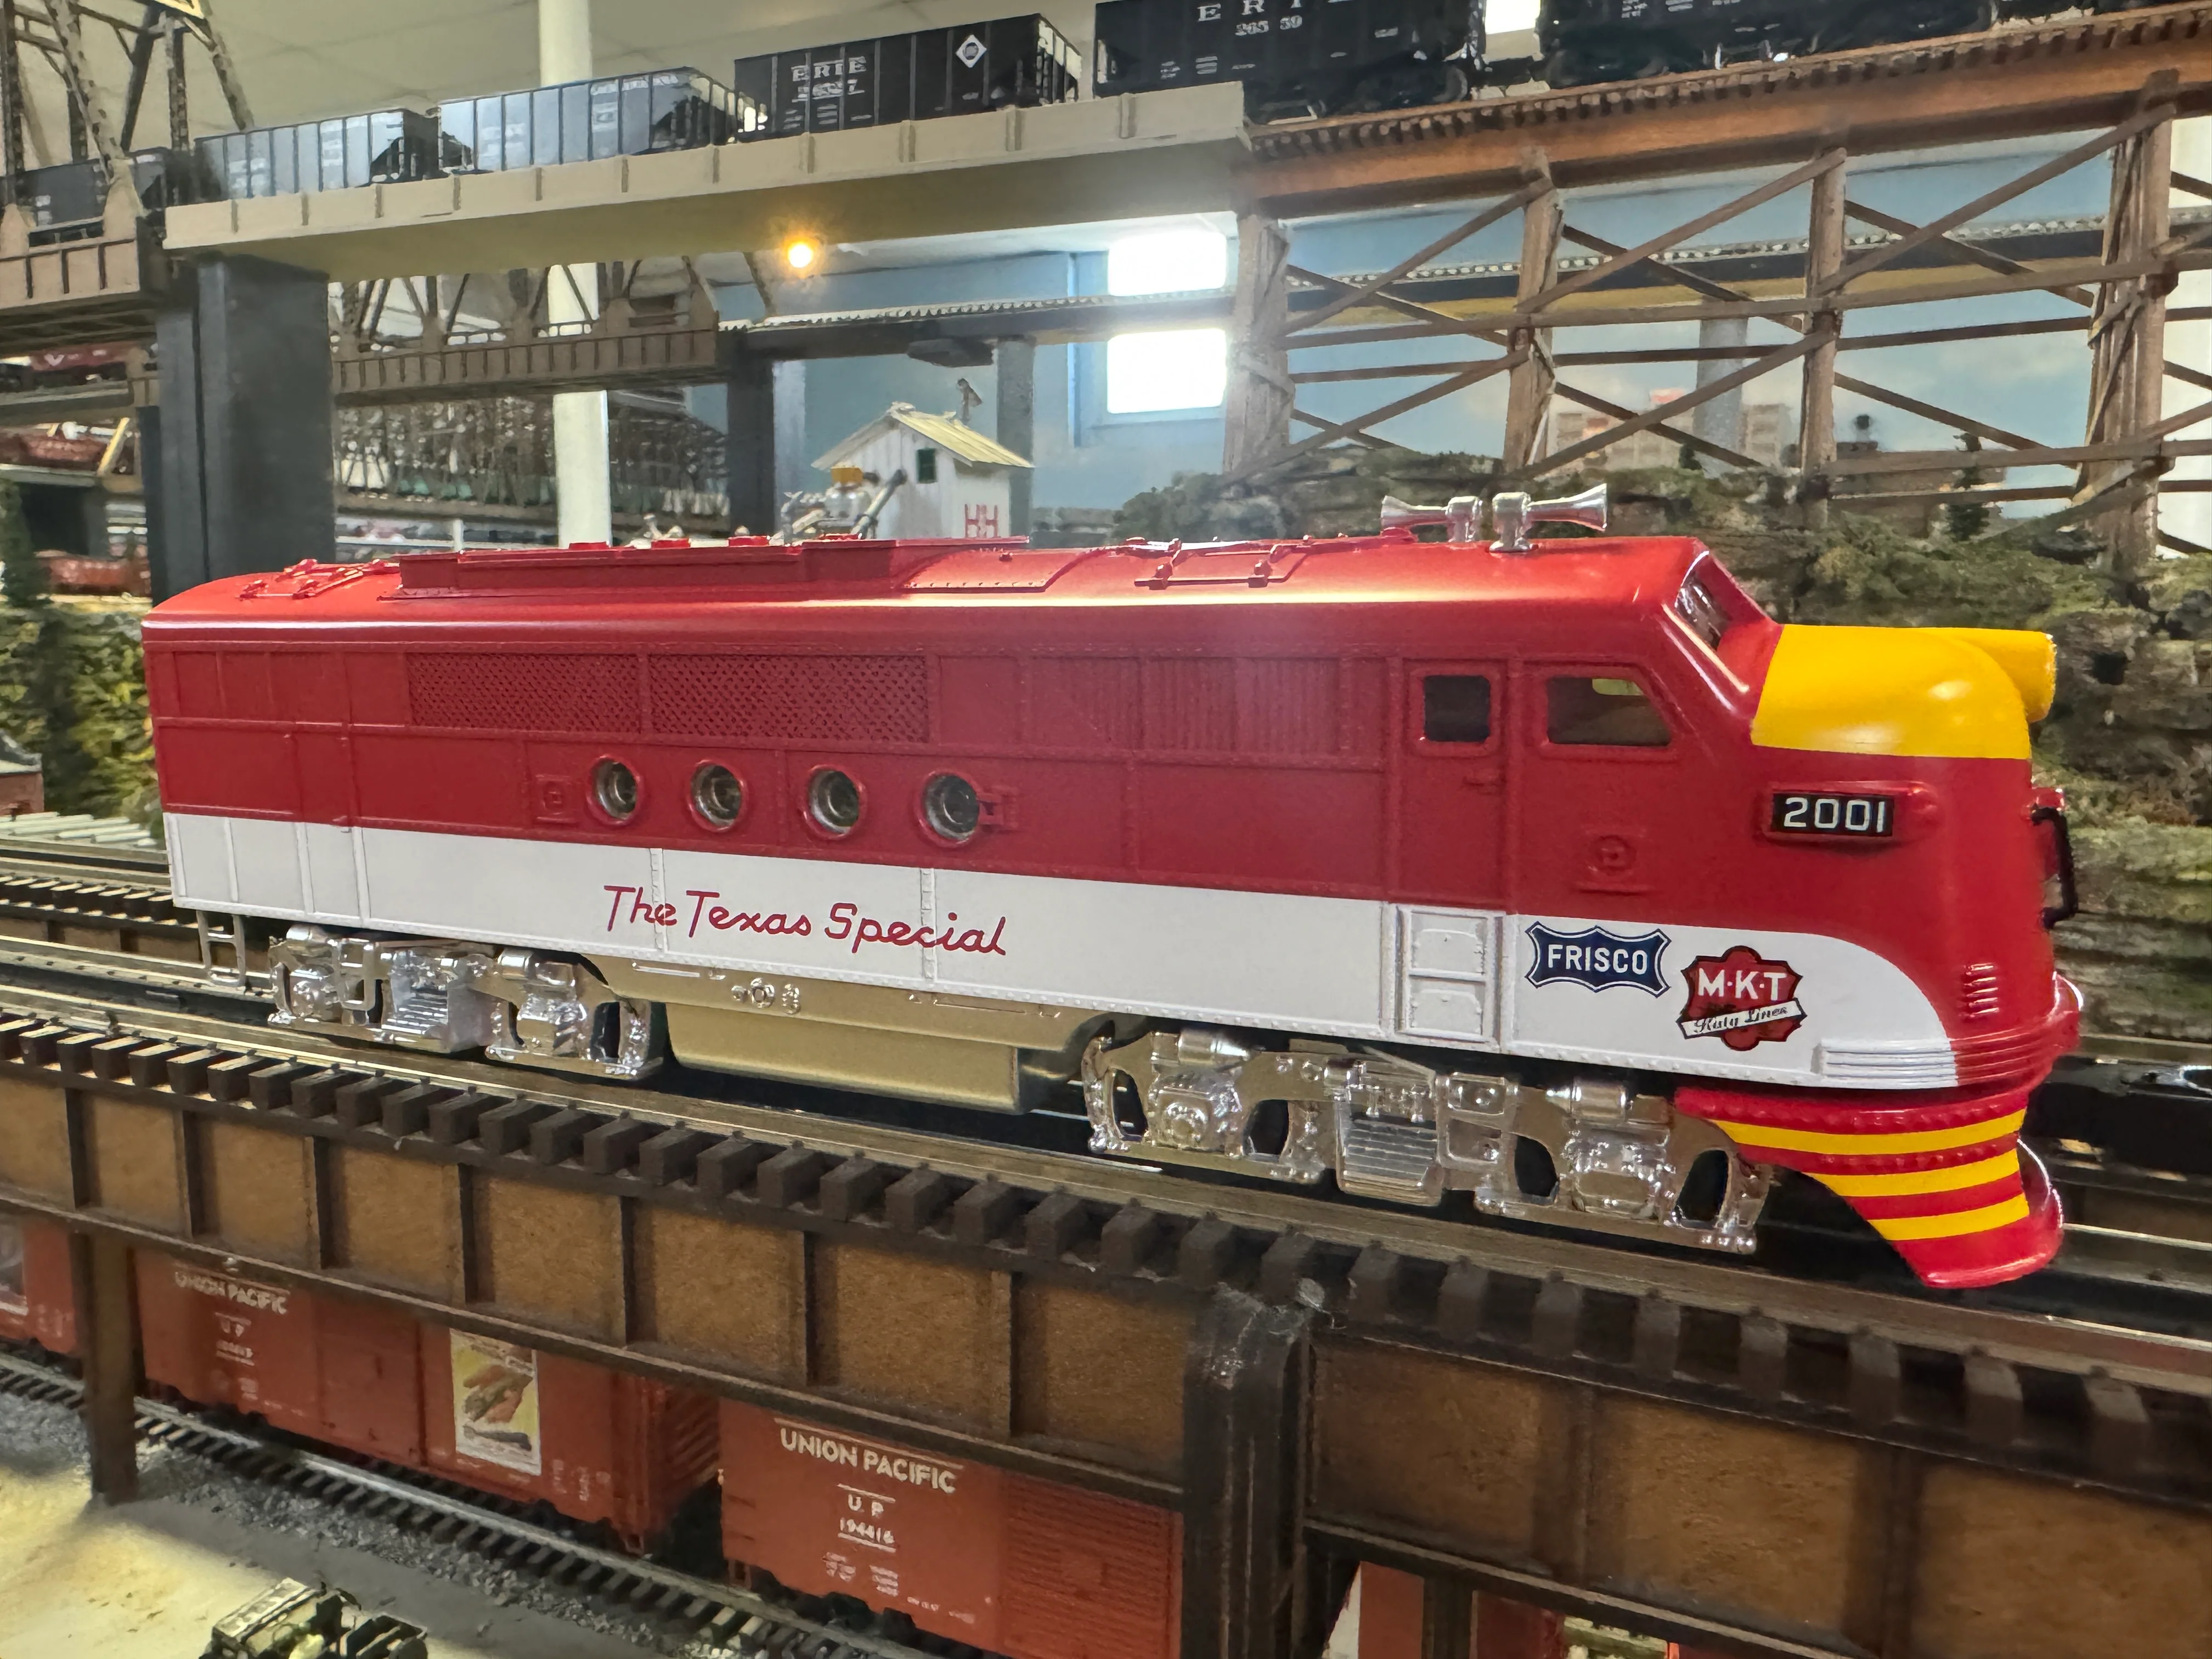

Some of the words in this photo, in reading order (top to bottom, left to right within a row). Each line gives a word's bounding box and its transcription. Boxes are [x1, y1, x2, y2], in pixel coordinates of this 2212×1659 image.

[791, 57, 867, 82] ERIE
[1784, 797, 1886, 833] 2001
[603, 885, 677, 932] The
[686, 890, 811, 938] Texas
[825, 902, 1006, 956] Special
[1547, 944, 1648, 975] FRISCO
[780, 1427, 858, 1467] UNION
[863, 1449, 958, 1493] PACIFIC
